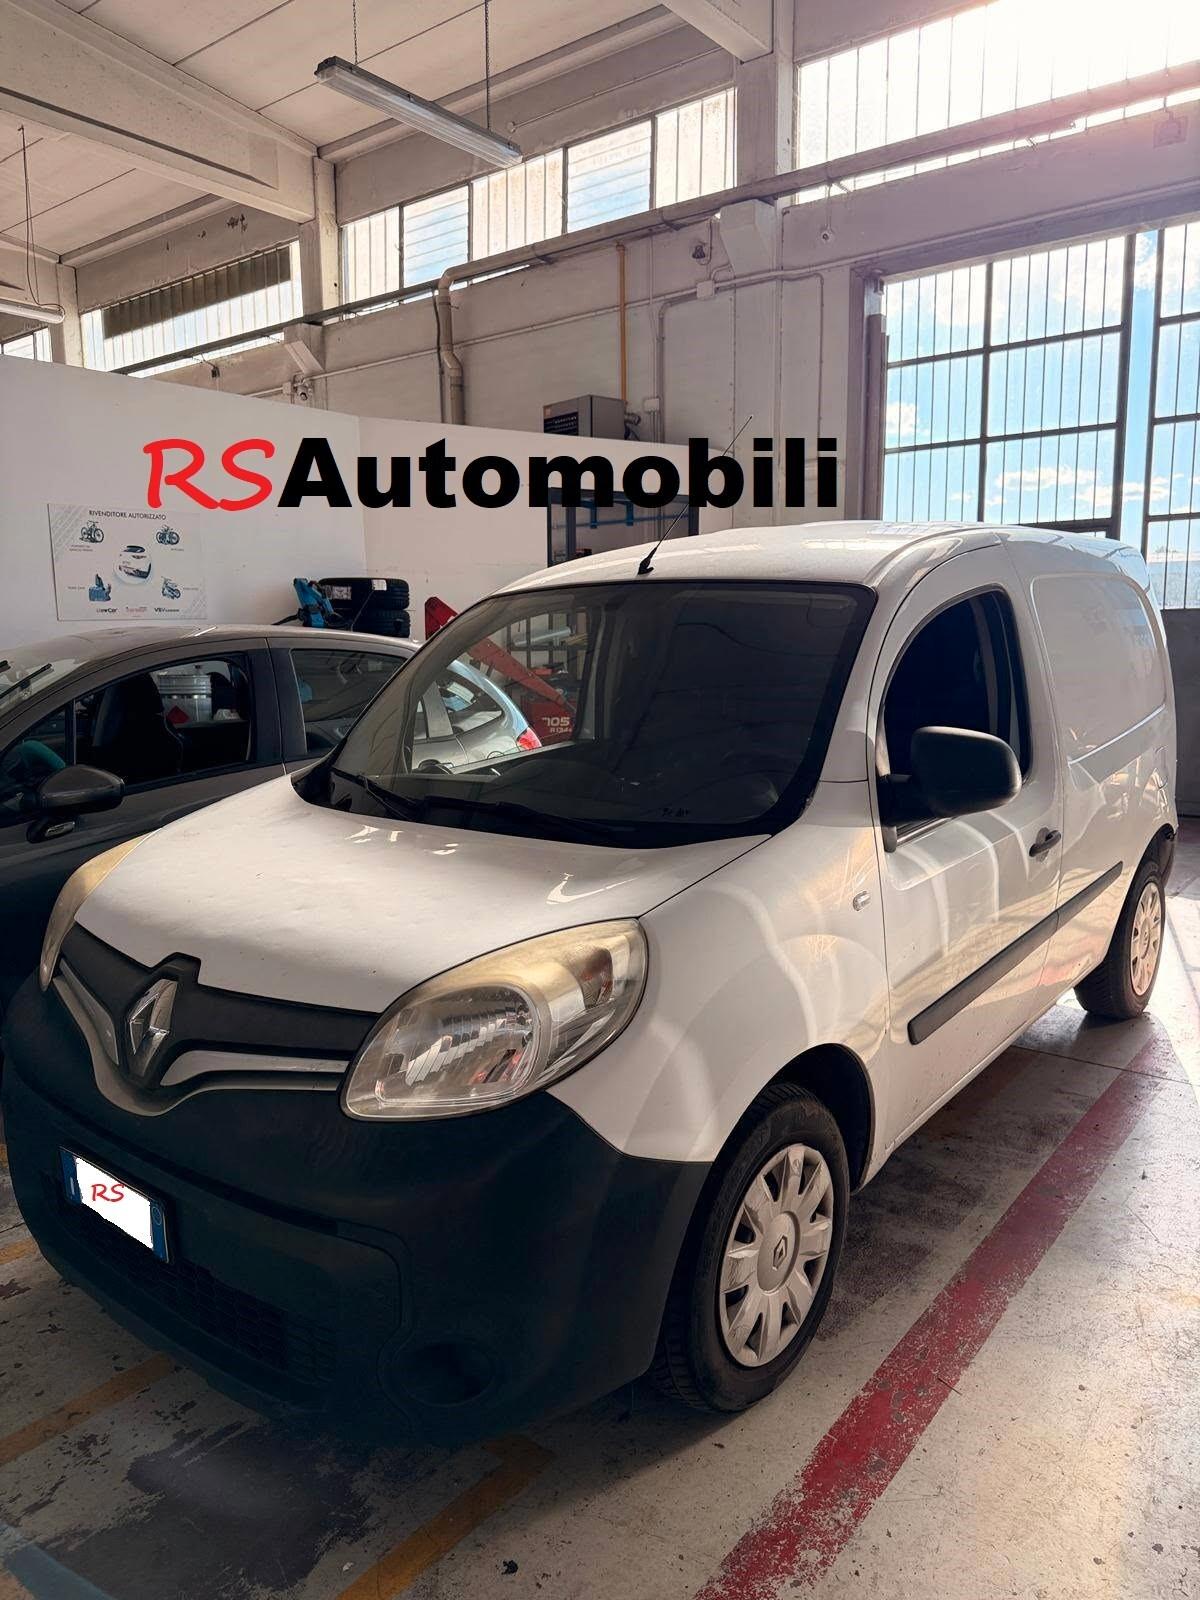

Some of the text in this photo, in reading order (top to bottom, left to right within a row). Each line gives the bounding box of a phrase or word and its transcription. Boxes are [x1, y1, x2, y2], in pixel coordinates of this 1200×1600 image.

[89, 510, 166, 520] RIVENDITORE AUTORIZZATO
[542, 716, 570, 726] 705
